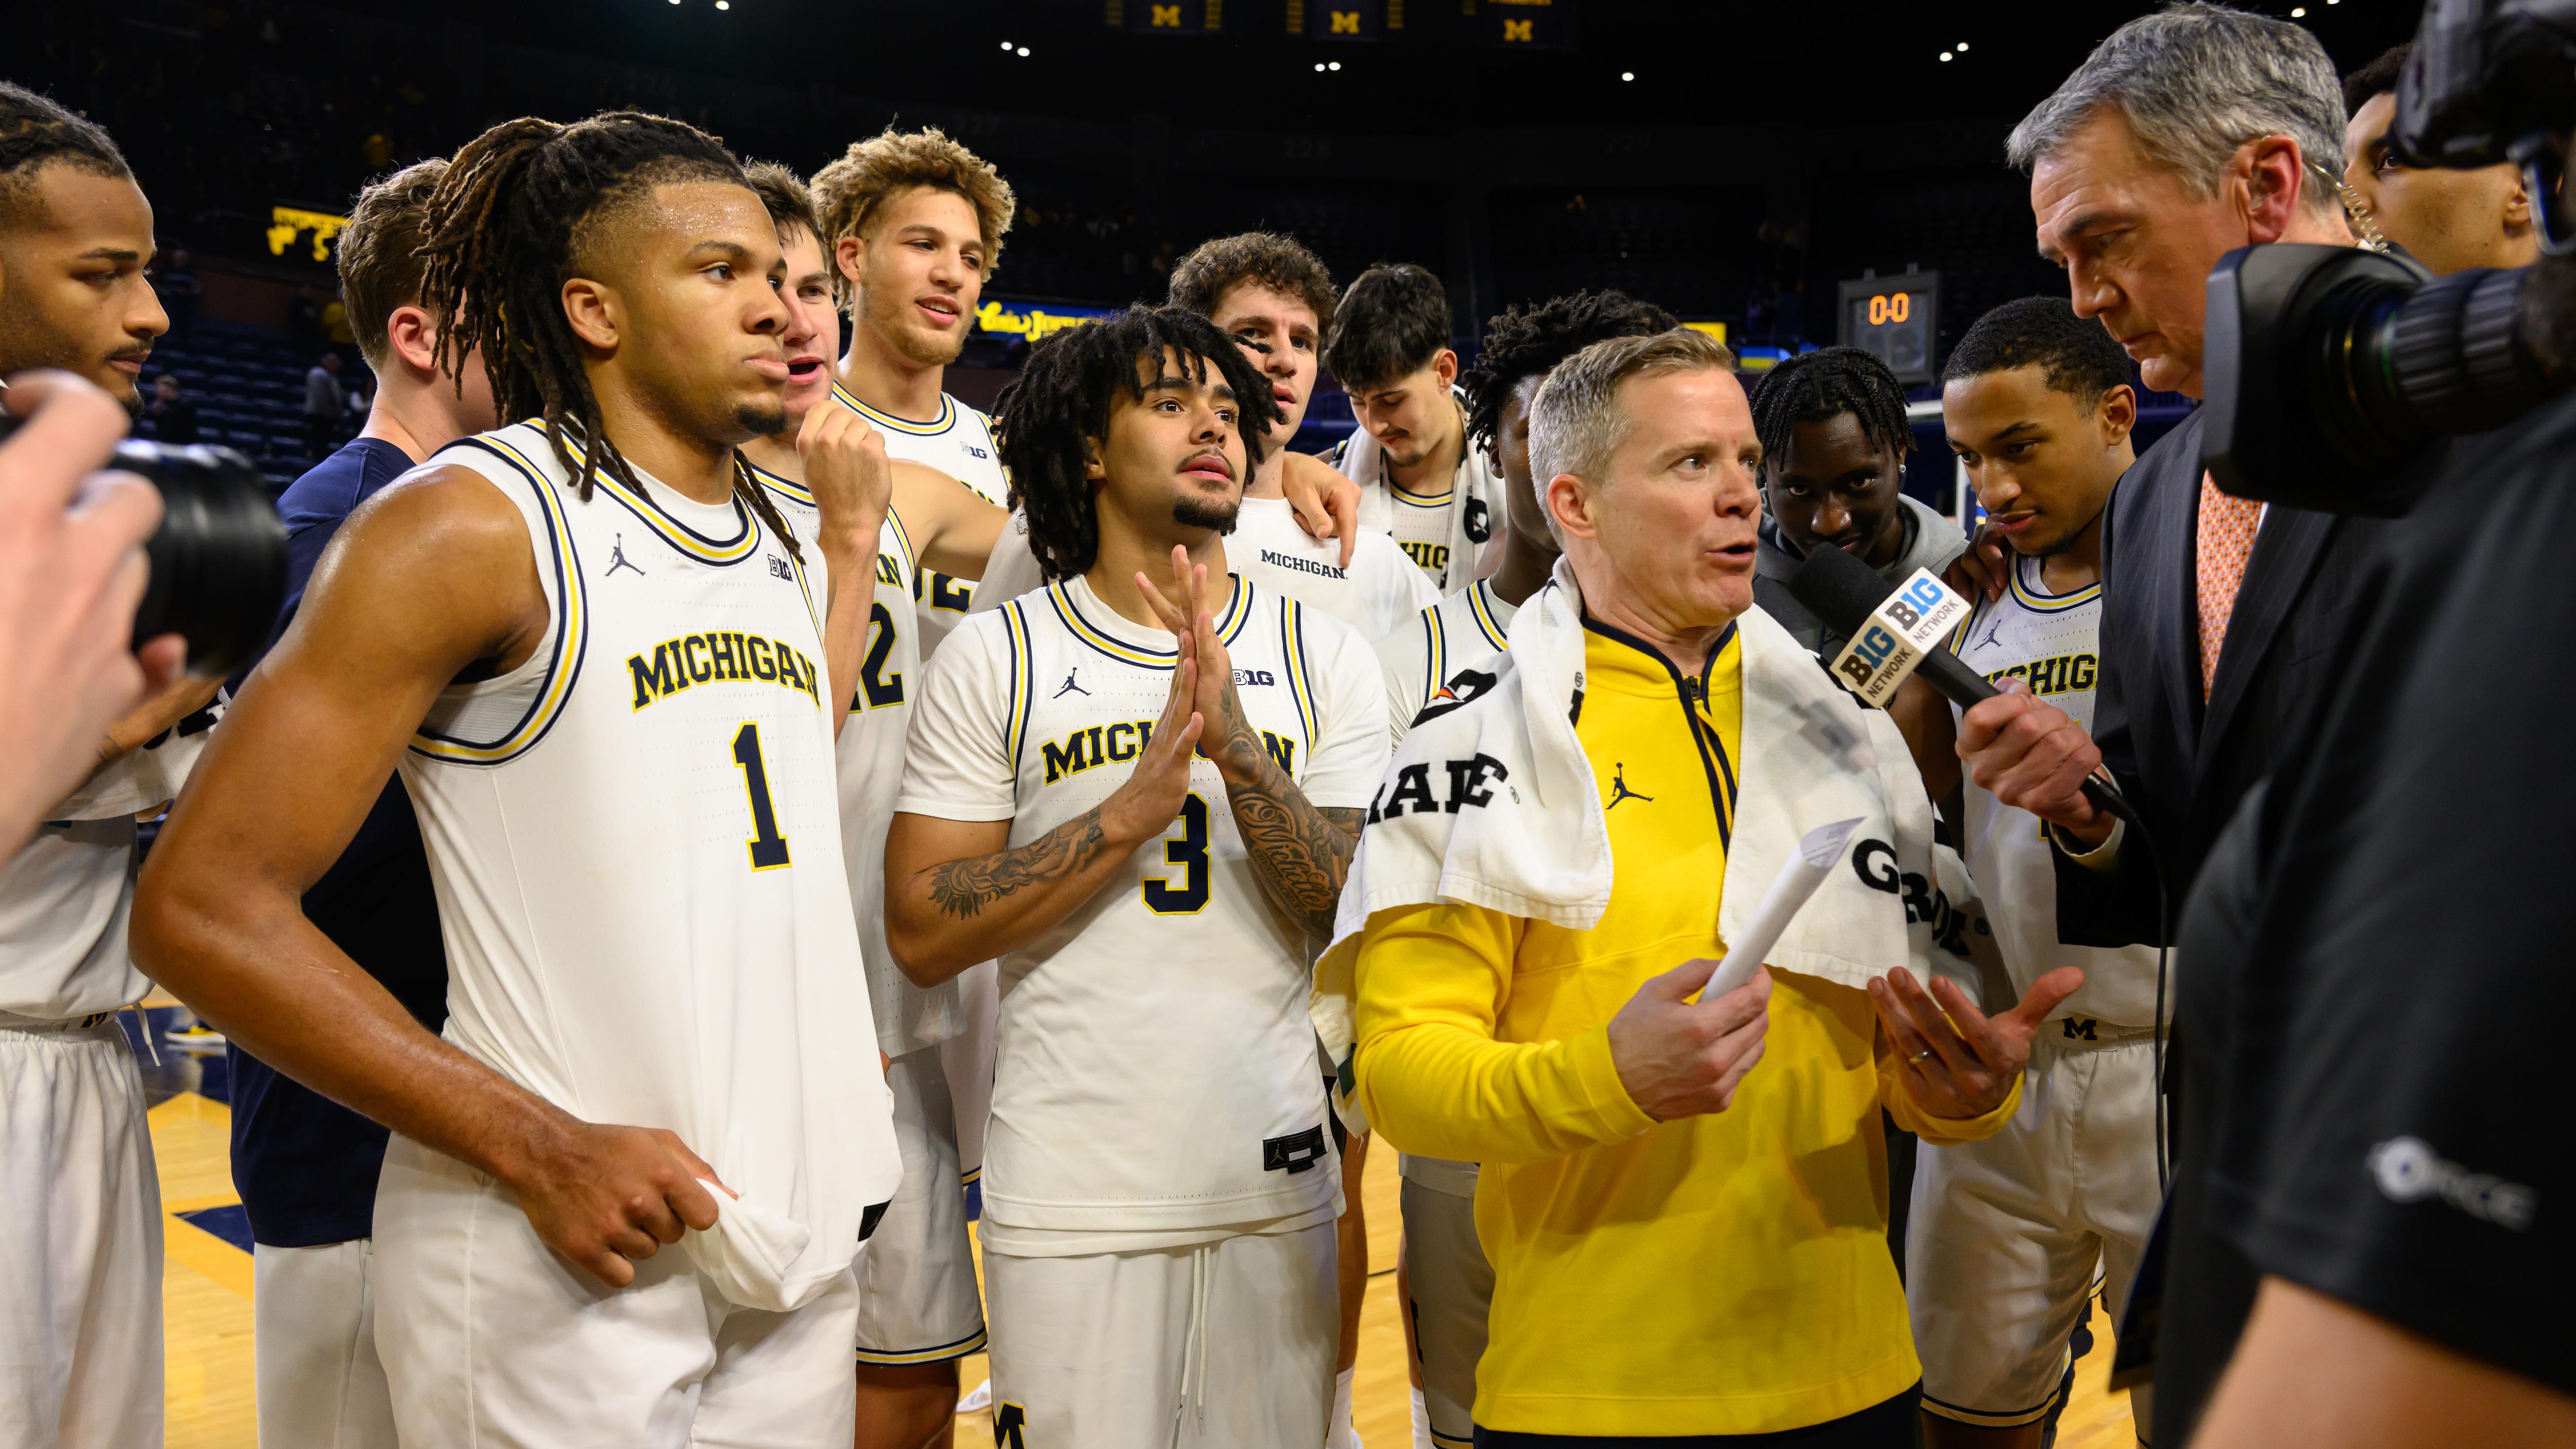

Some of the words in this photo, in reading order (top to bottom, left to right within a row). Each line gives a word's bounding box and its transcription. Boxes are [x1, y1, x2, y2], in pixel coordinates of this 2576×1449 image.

[1150, 4, 1181, 27] M
[1331, 11, 1360, 34] M
[1503, 19, 1533, 42] M
[1261, 549, 1346, 580] MICHIGAN
[1913, 599, 1959, 643] NETWORK
[625, 631, 821, 714] MICHIGAN
[1867, 648, 1912, 698] NETWORK
[731, 721, 792, 872] 1
[1141, 791, 1212, 916] 3
[2062, 1017, 2097, 1040] M
